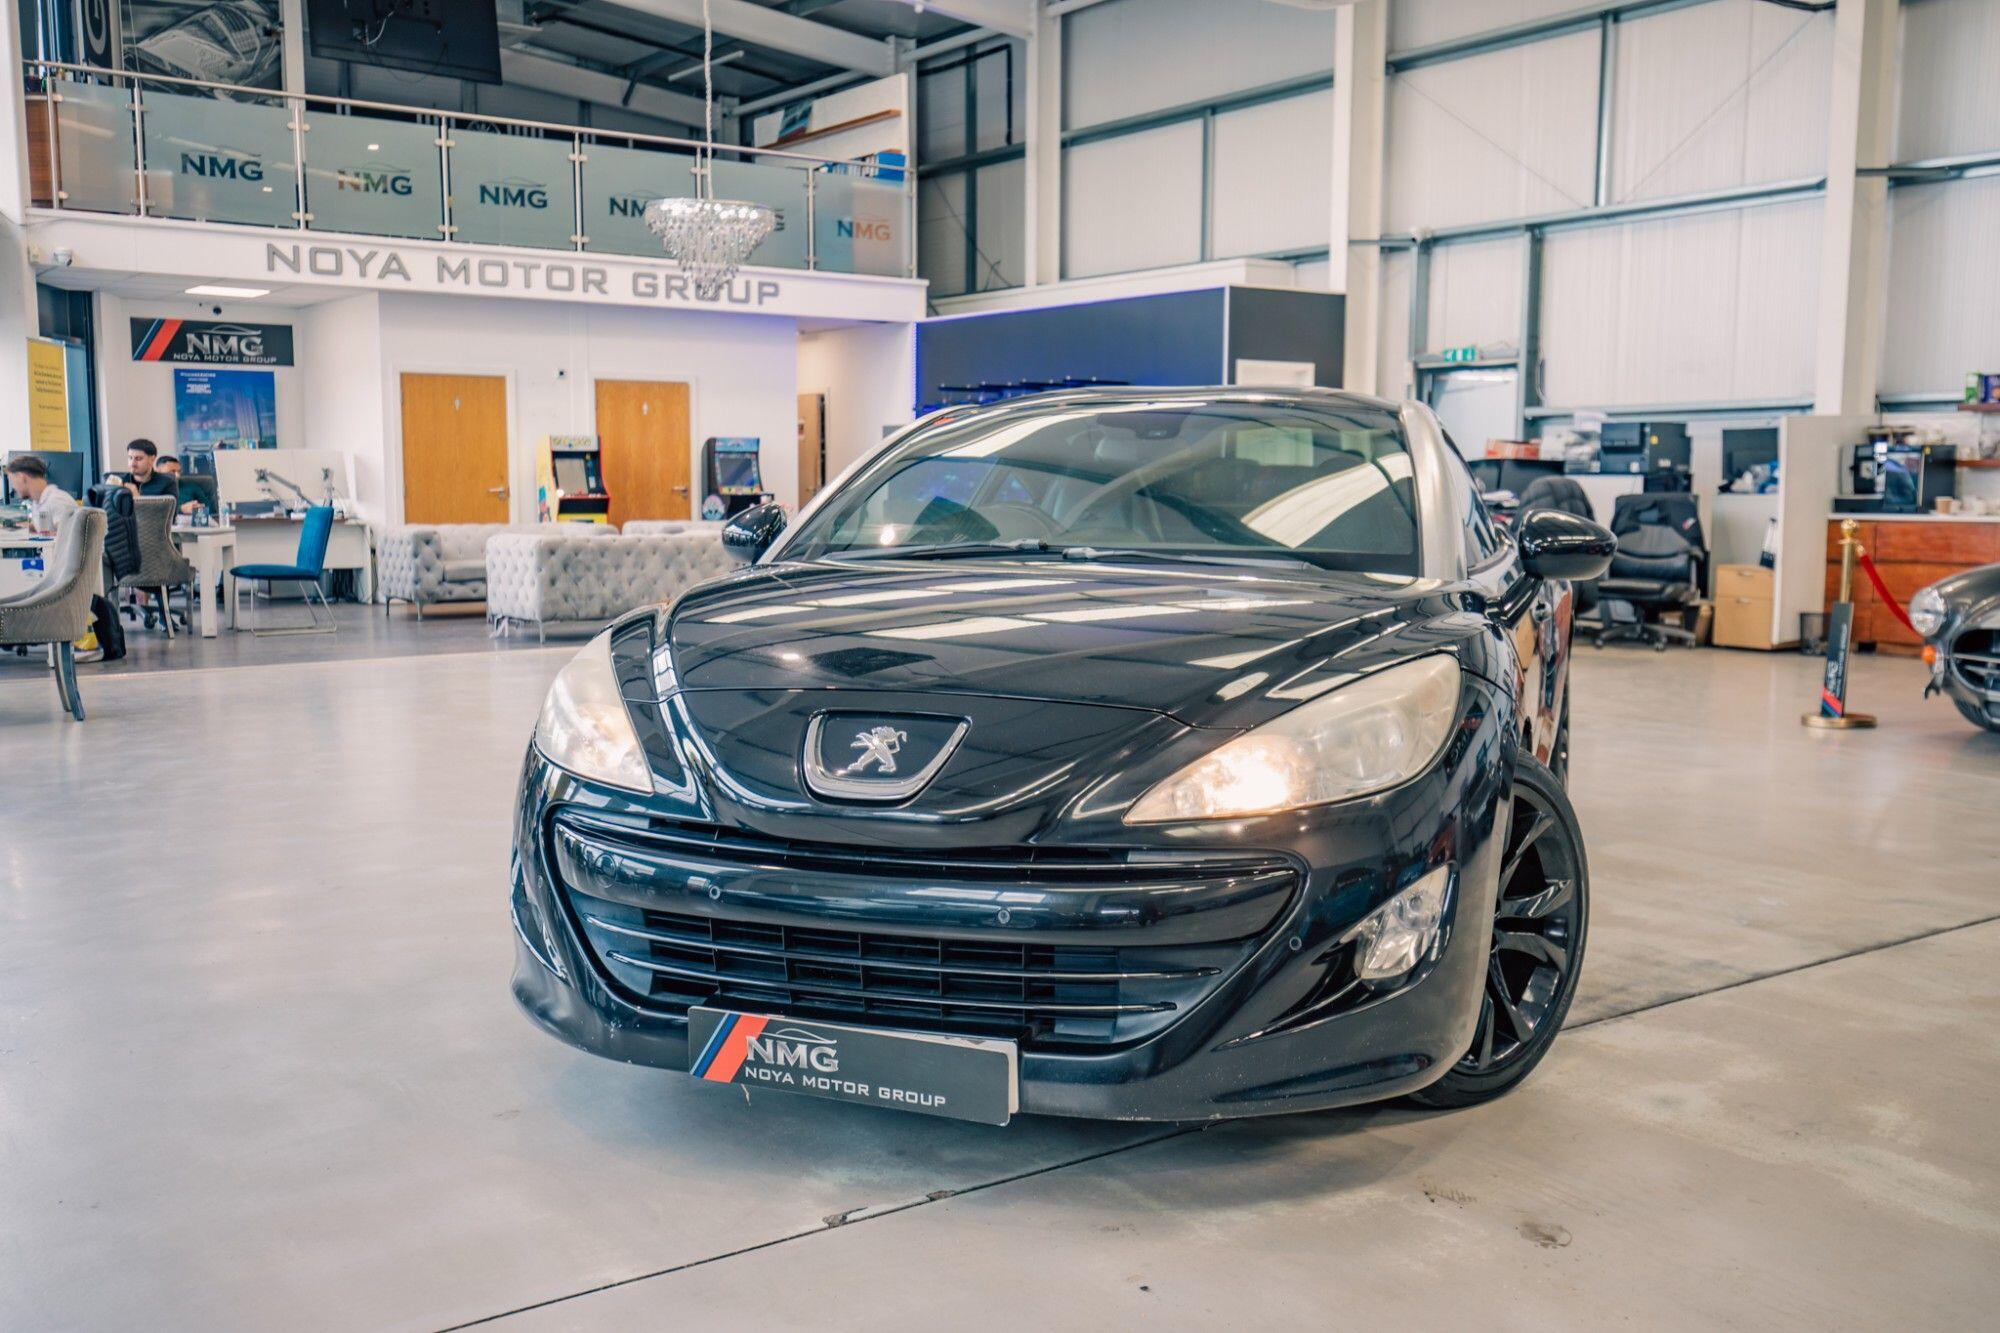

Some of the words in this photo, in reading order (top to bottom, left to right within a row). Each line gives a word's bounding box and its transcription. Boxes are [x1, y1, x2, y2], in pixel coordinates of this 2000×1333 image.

[181, 152, 264, 182] NMG
[337, 168, 413, 196] NMG
[479, 184, 548, 209] NMG
[609, 196, 648, 218] NM
[837, 219, 891, 241] NMG
[266, 243, 412, 282] NOYA
[437, 255, 608, 295] MOTOR
[186, 333, 264, 356] NMG
[173, 353, 200, 361] NOYA
[204, 354, 239, 363] MOTOR
[242, 356, 277, 364] GROUP
[746, 1036, 839, 1073] NMG
[745, 1066, 795, 1086] NOYA
[802, 1075, 869, 1097] MOTOR
[879, 1086, 946, 1108] GROUP
